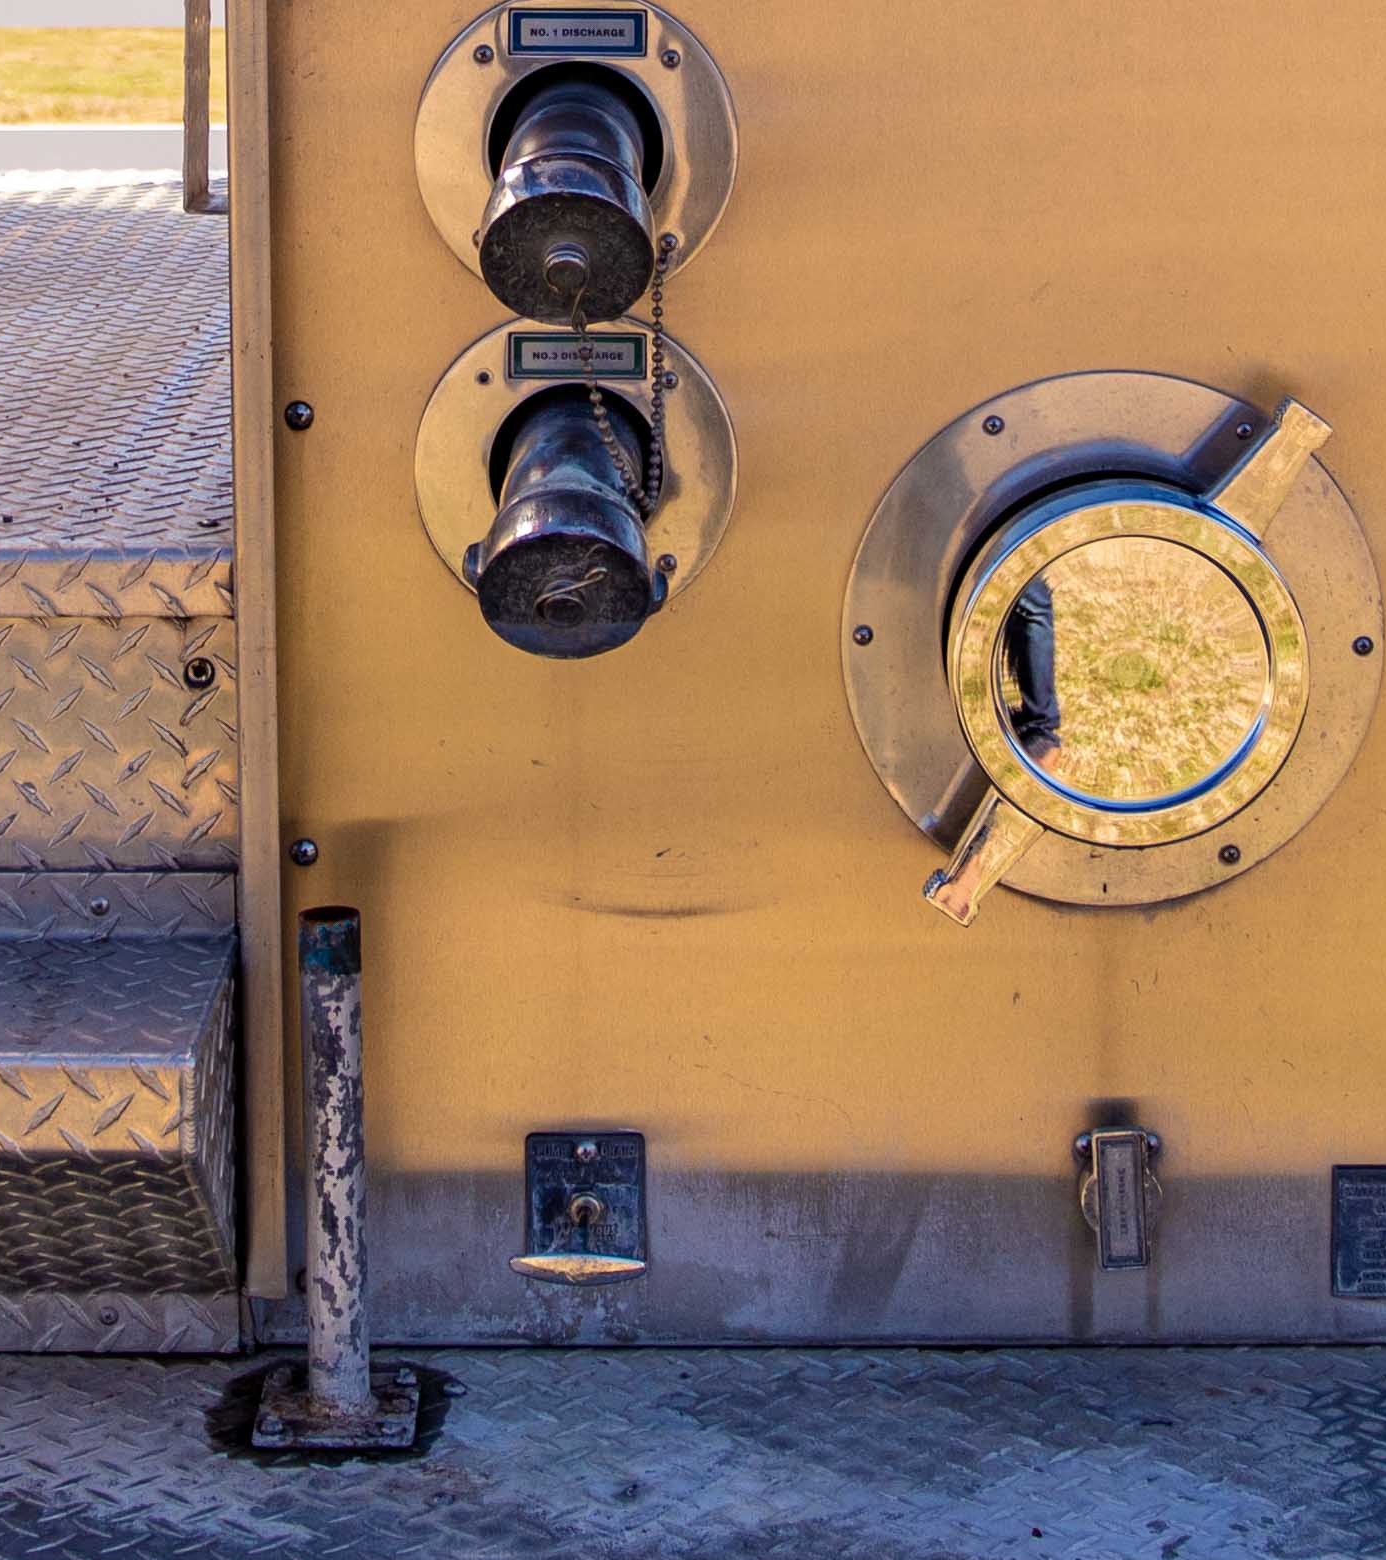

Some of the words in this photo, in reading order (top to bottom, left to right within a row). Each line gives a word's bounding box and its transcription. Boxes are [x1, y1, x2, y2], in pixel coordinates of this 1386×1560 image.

[529, 27, 549, 37] NO.
[552, 28, 558, 37] 1
[562, 27, 626, 37] DISCHARGE
